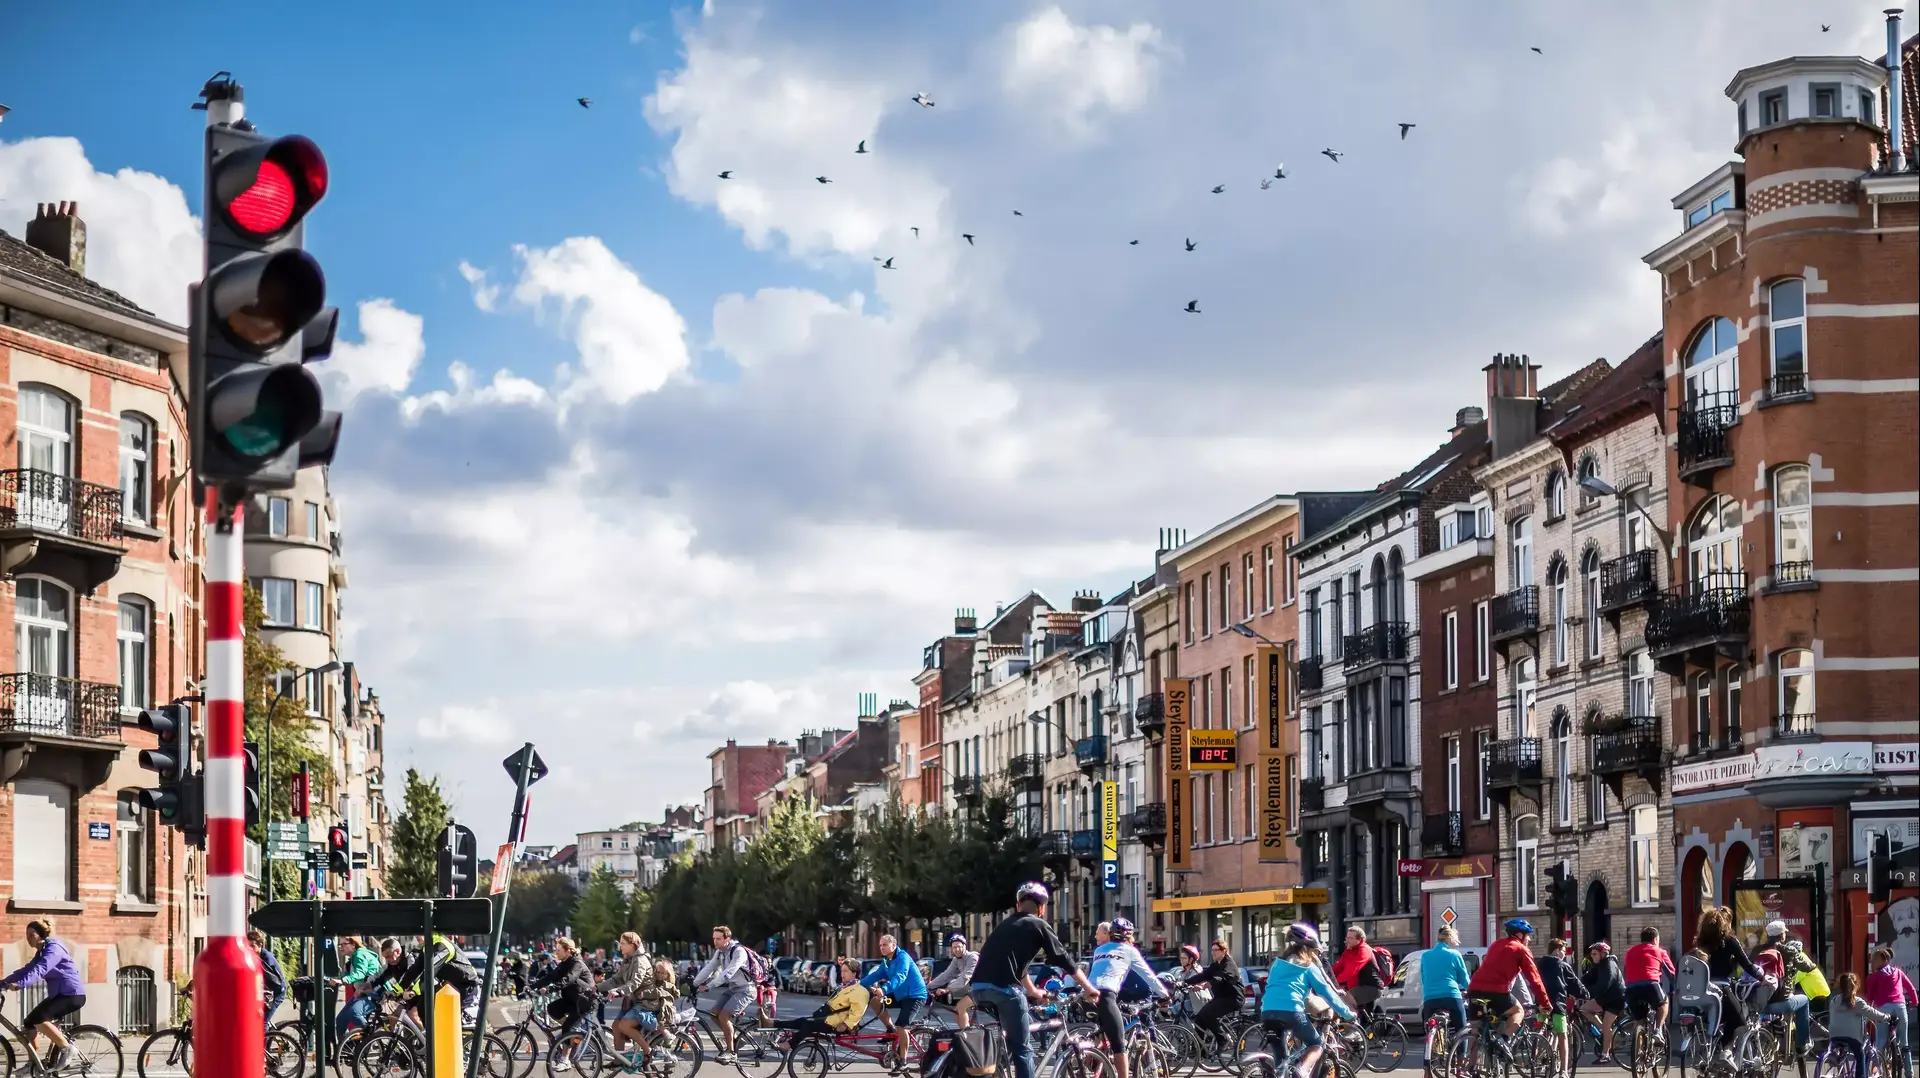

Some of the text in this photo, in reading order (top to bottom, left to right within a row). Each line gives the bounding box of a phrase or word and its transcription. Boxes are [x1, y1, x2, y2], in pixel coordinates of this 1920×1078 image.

[1166, 690, 1186, 771] Steylemans
[1191, 736, 1235, 747] Steylemans
[1200, 749, 1229, 761] 18°C
[1874, 750, 1918, 764] RIST
[1672, 767, 1719, 786] RISTORANTE
[1263, 757, 1286, 848] Steylemans
[1105, 785, 1116, 840] Steylemans
[1104, 863, 1117, 879] P
[325, 938, 332, 949] P
